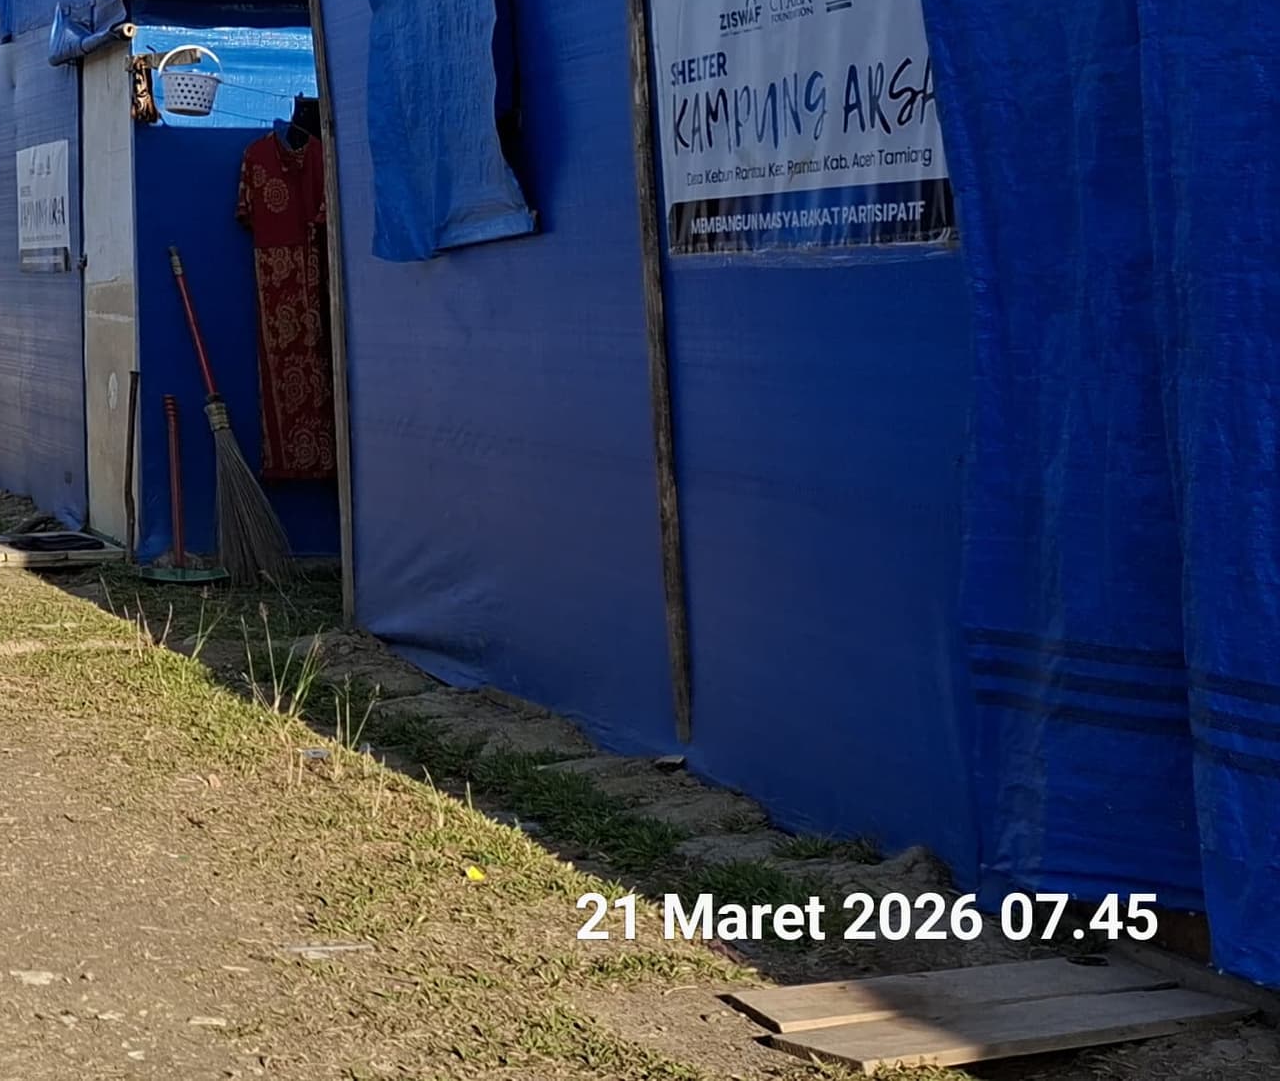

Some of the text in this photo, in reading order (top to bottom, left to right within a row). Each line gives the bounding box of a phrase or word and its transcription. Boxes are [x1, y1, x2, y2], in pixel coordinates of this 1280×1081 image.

[720, 5, 762, 31] ZISWAF
[671, 51, 728, 86] SHELTER
[673, 70, 827, 157] KAMPUNG
[823, 153, 850, 172] Kab.
[690, 213, 759, 235] MEMBANGUN
[759, 206, 841, 231] MASYARAKAT
